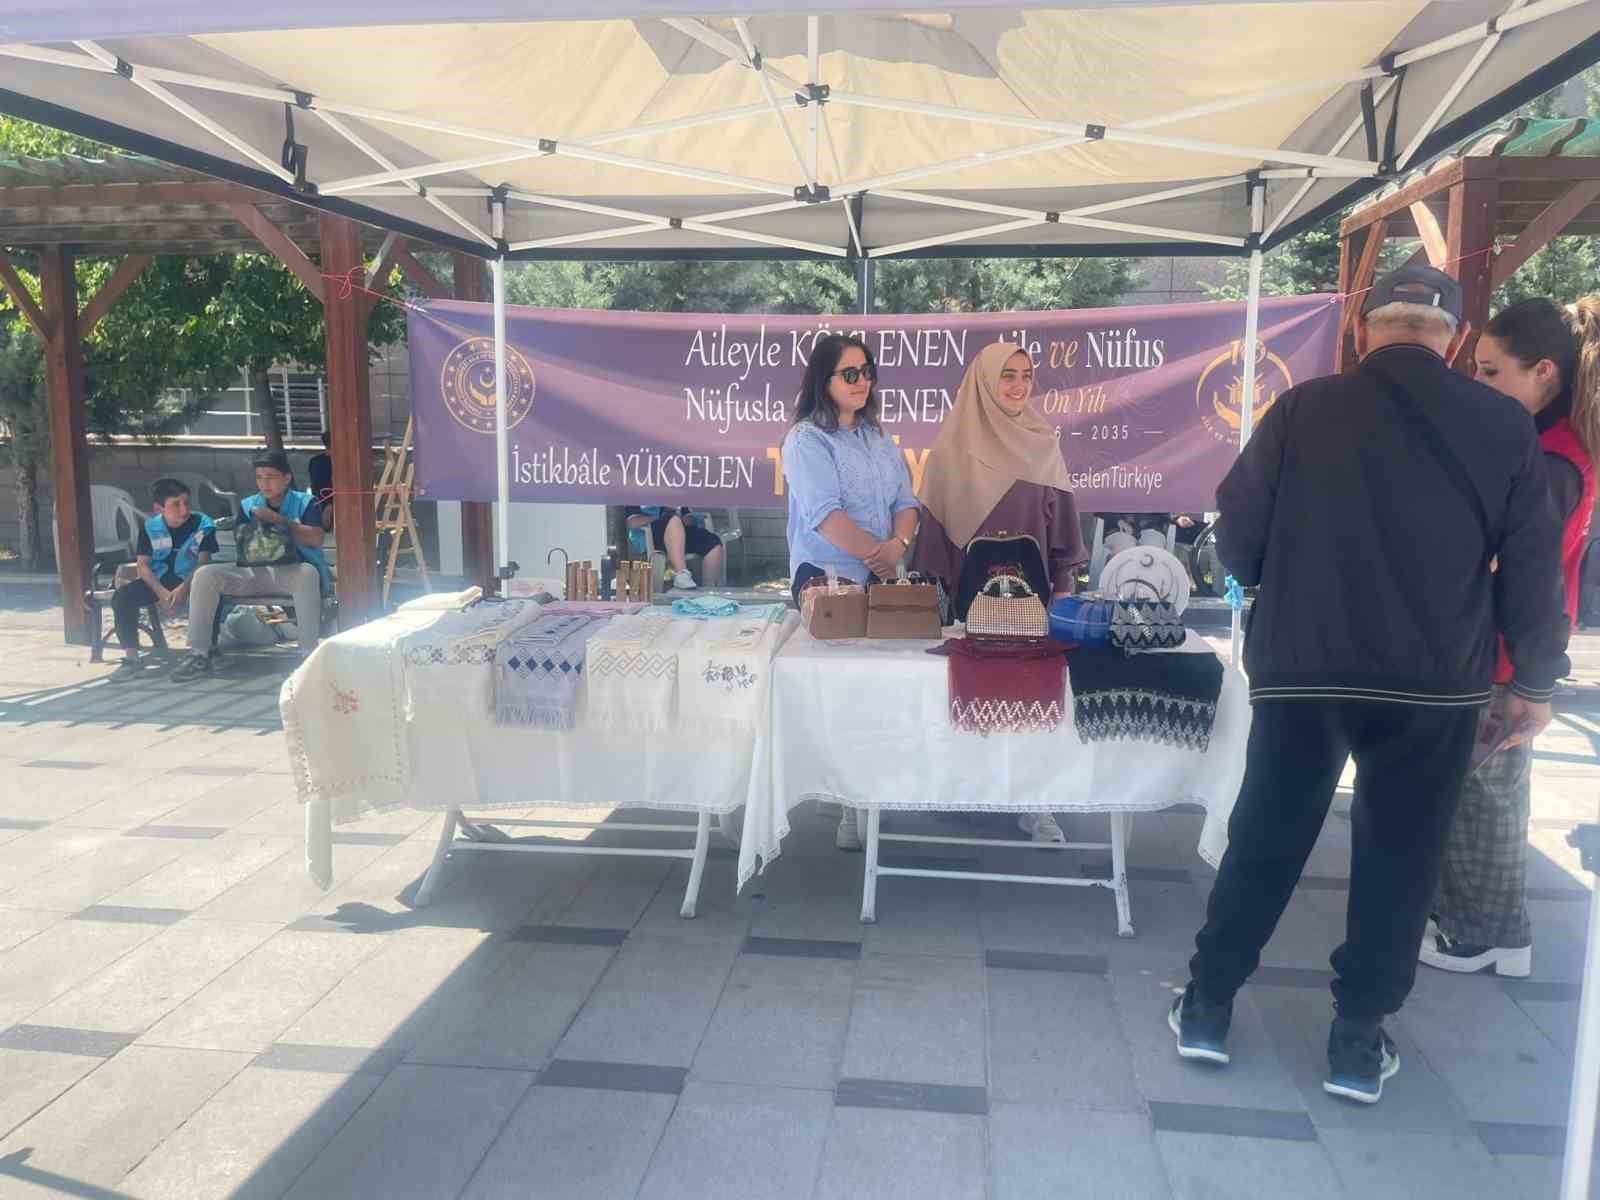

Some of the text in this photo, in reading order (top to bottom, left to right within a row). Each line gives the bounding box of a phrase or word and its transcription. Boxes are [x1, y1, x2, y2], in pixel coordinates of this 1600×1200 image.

[685, 324, 781, 381] Aileyle
[1050, 339, 1078, 369] ve
[1085, 327, 1165, 368] Nüfus
[683, 383, 788, 434] Nüfusla
[1043, 388, 1072, 415] On
[1091, 424, 1129, 441] 2035
[512, 444, 611, 485] İstikbâle
[615, 448, 755, 489] YÜKSELEN
